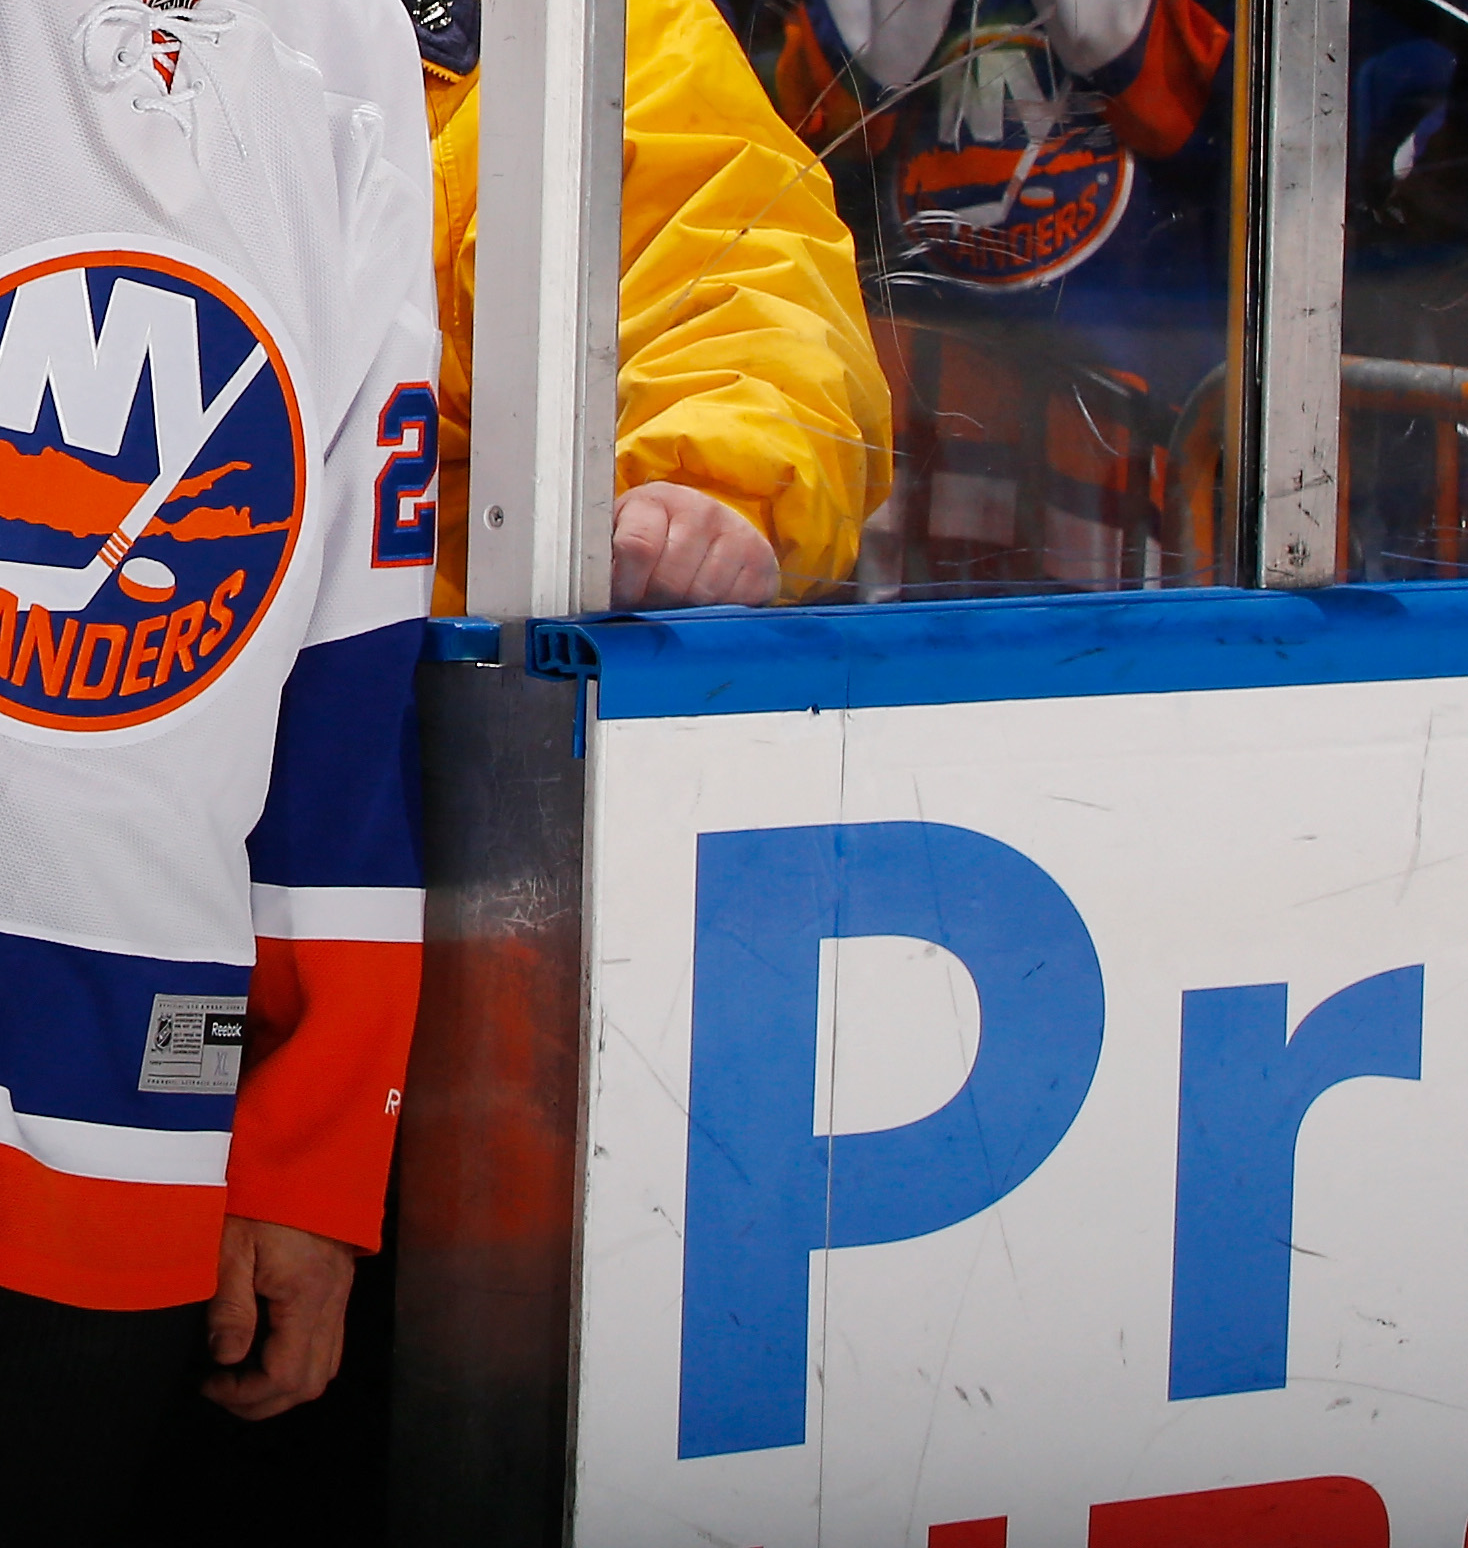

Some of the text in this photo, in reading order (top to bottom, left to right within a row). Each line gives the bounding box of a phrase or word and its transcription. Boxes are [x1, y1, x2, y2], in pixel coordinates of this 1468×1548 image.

[370, 380, 439, 569] 2
[211, 1021, 243, 1038] Reebok
[677, 820, 1426, 1460] Pr
